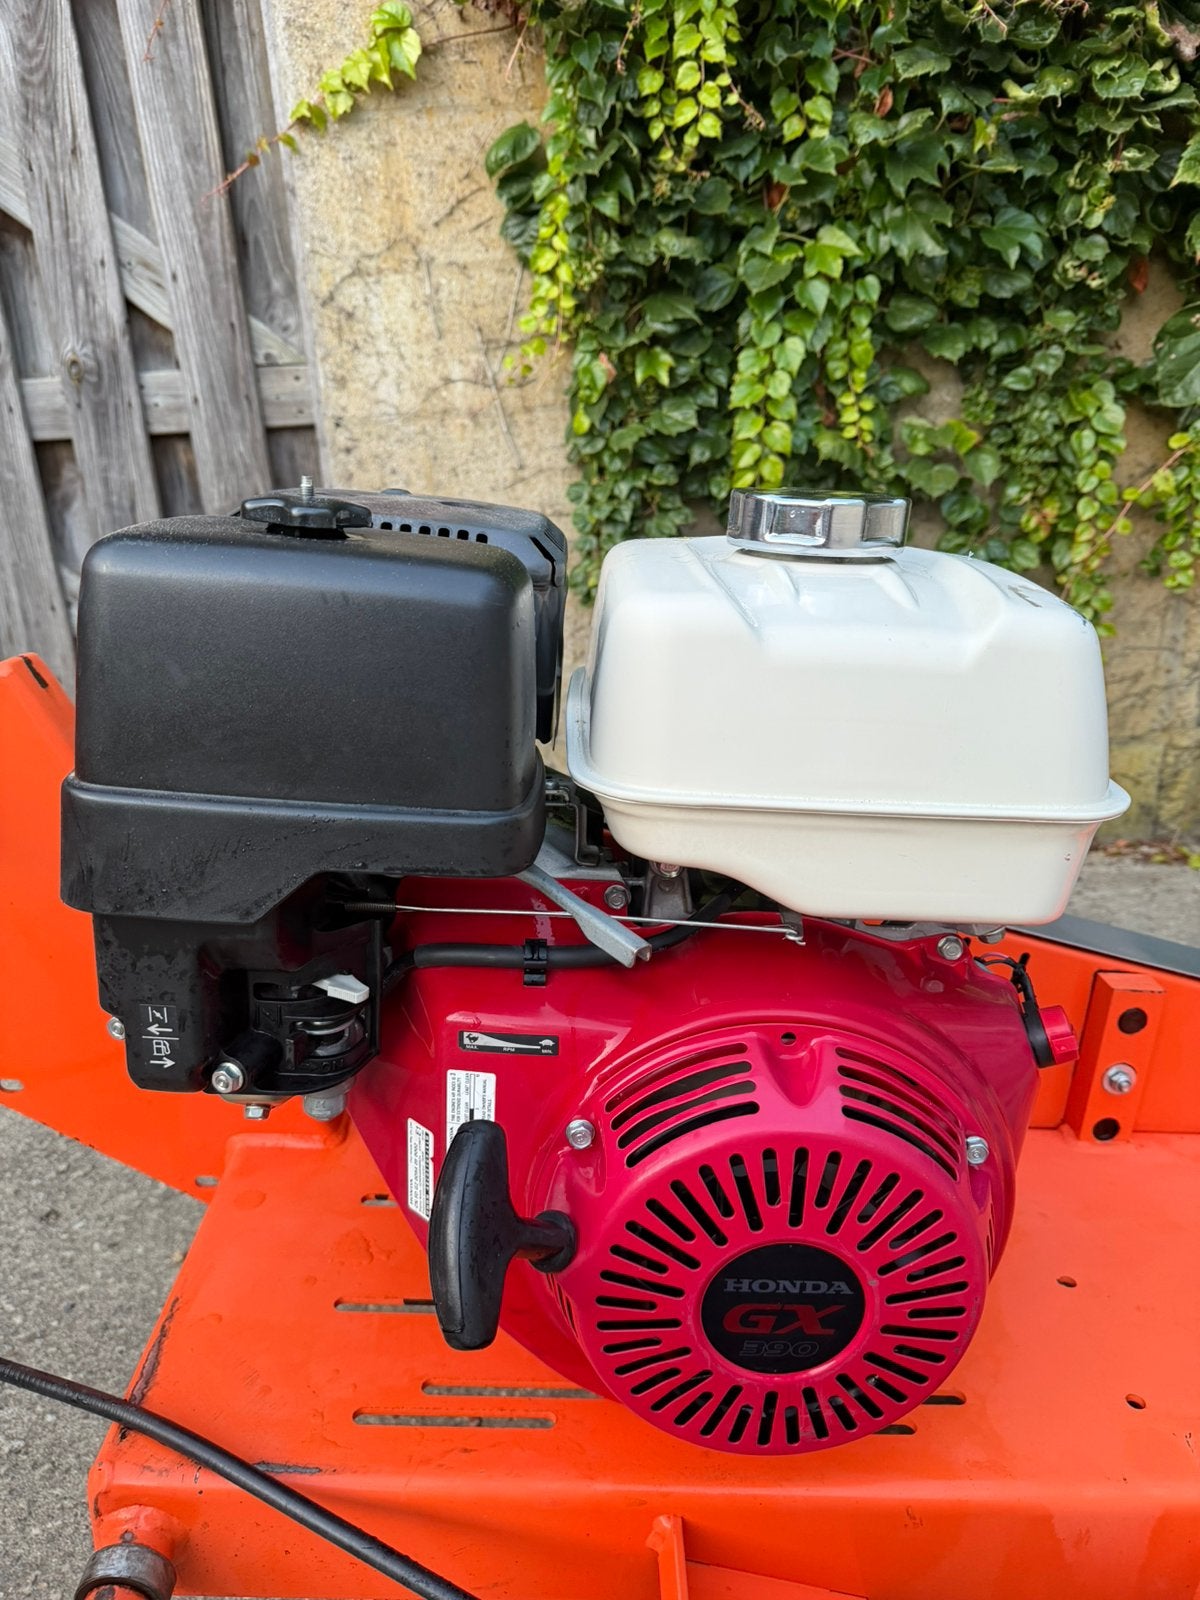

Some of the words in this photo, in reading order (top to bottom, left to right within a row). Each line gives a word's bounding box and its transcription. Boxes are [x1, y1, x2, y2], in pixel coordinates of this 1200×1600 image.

[723, 1278, 854, 1294] HONDA
[723, 1303, 847, 1335] GX
[739, 1340, 819, 1358] 390
